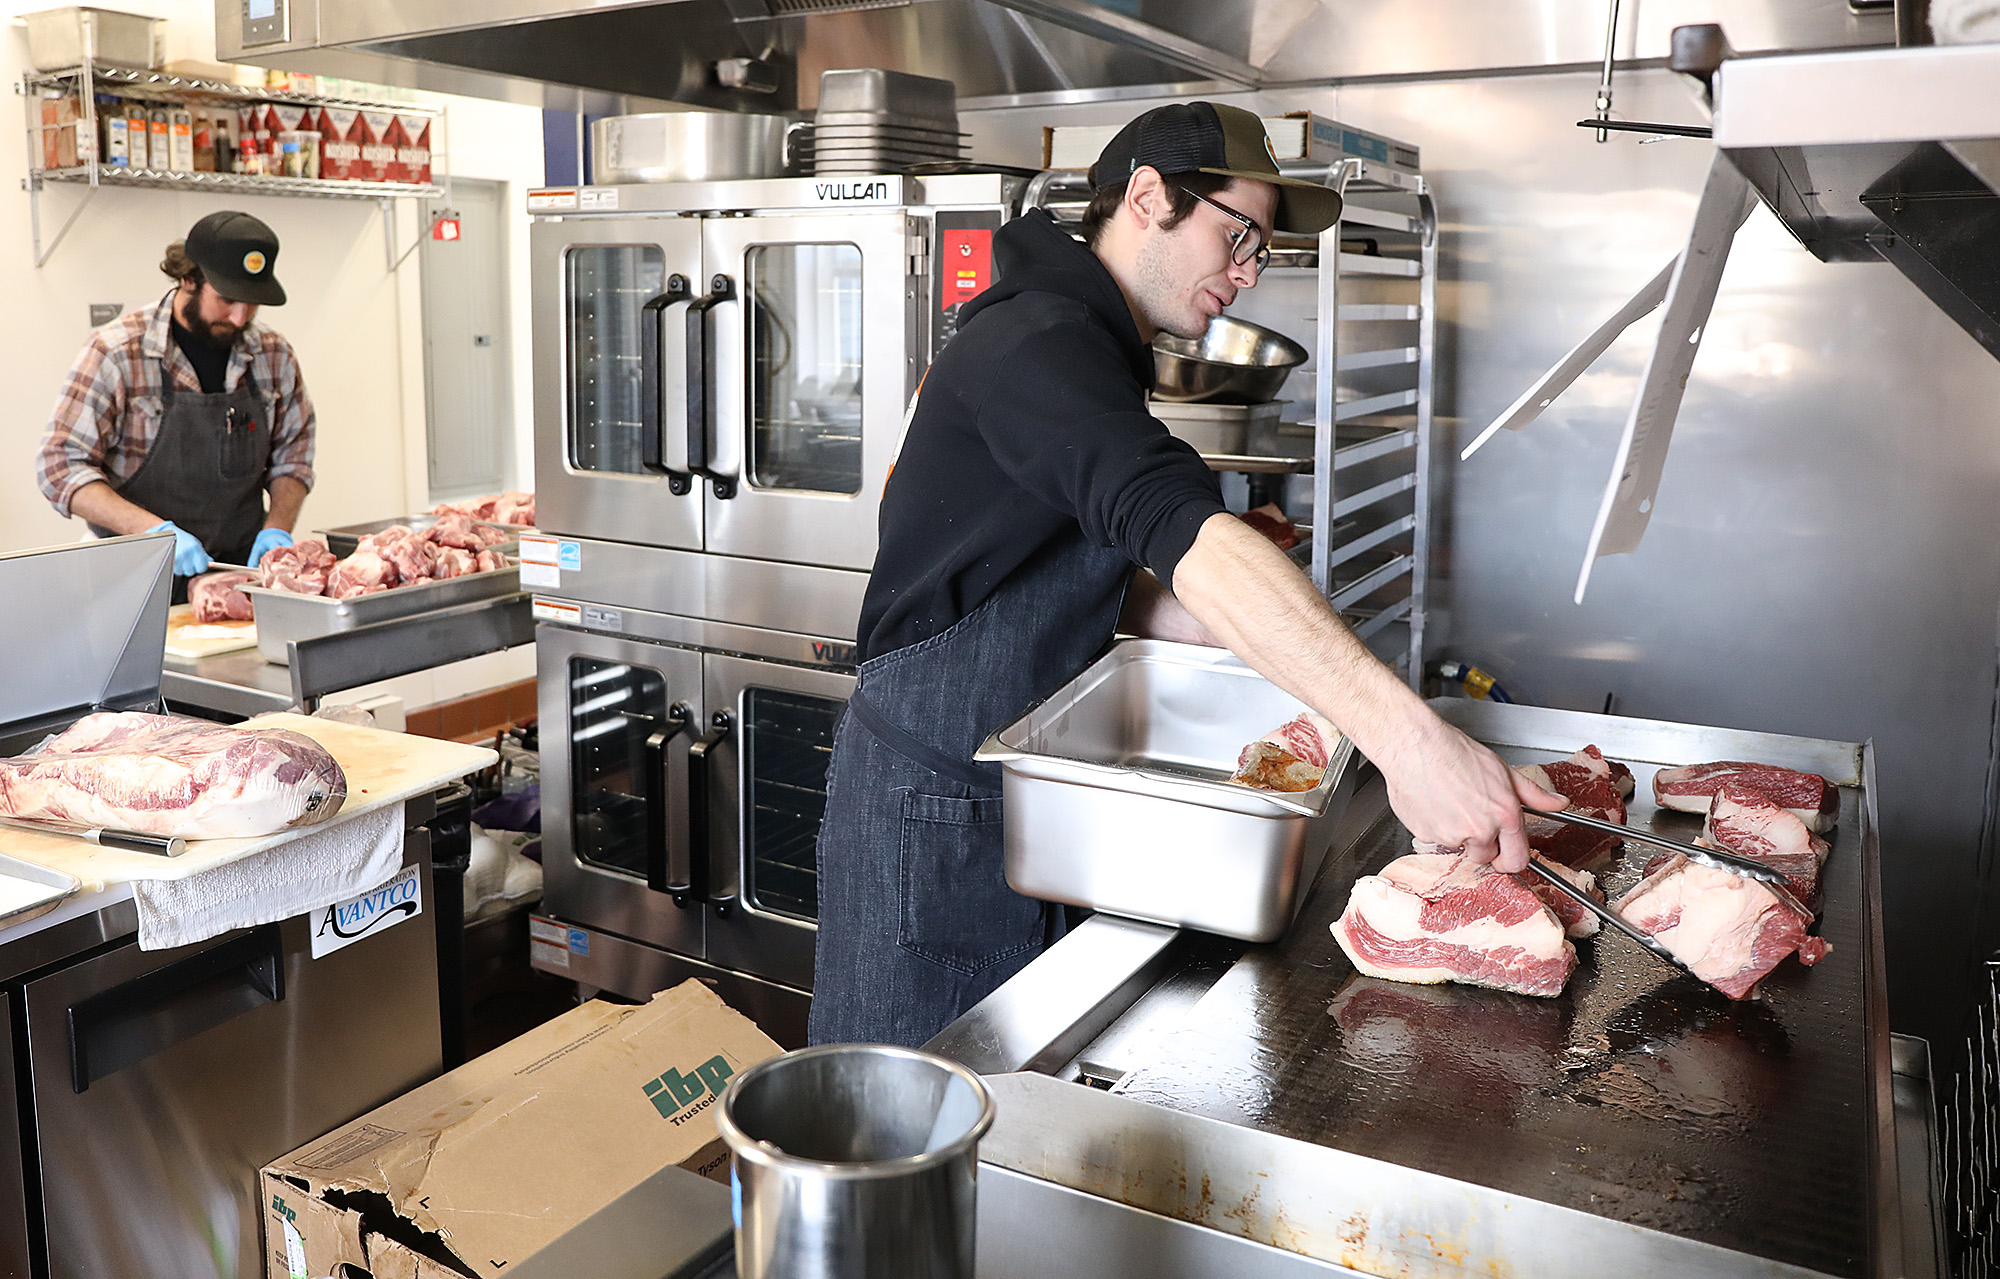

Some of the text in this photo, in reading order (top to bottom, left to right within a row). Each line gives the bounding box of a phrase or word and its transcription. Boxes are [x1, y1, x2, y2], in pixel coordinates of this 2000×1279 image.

[815, 182, 887, 200] VULCAN
[316, 878, 418, 939] AVANTCO
[641, 1055, 735, 1119] ibp
[669, 1093, 717, 1127] Trusted
[698, 1152, 727, 1177] Tyson
[272, 1194, 297, 1224] ibp
